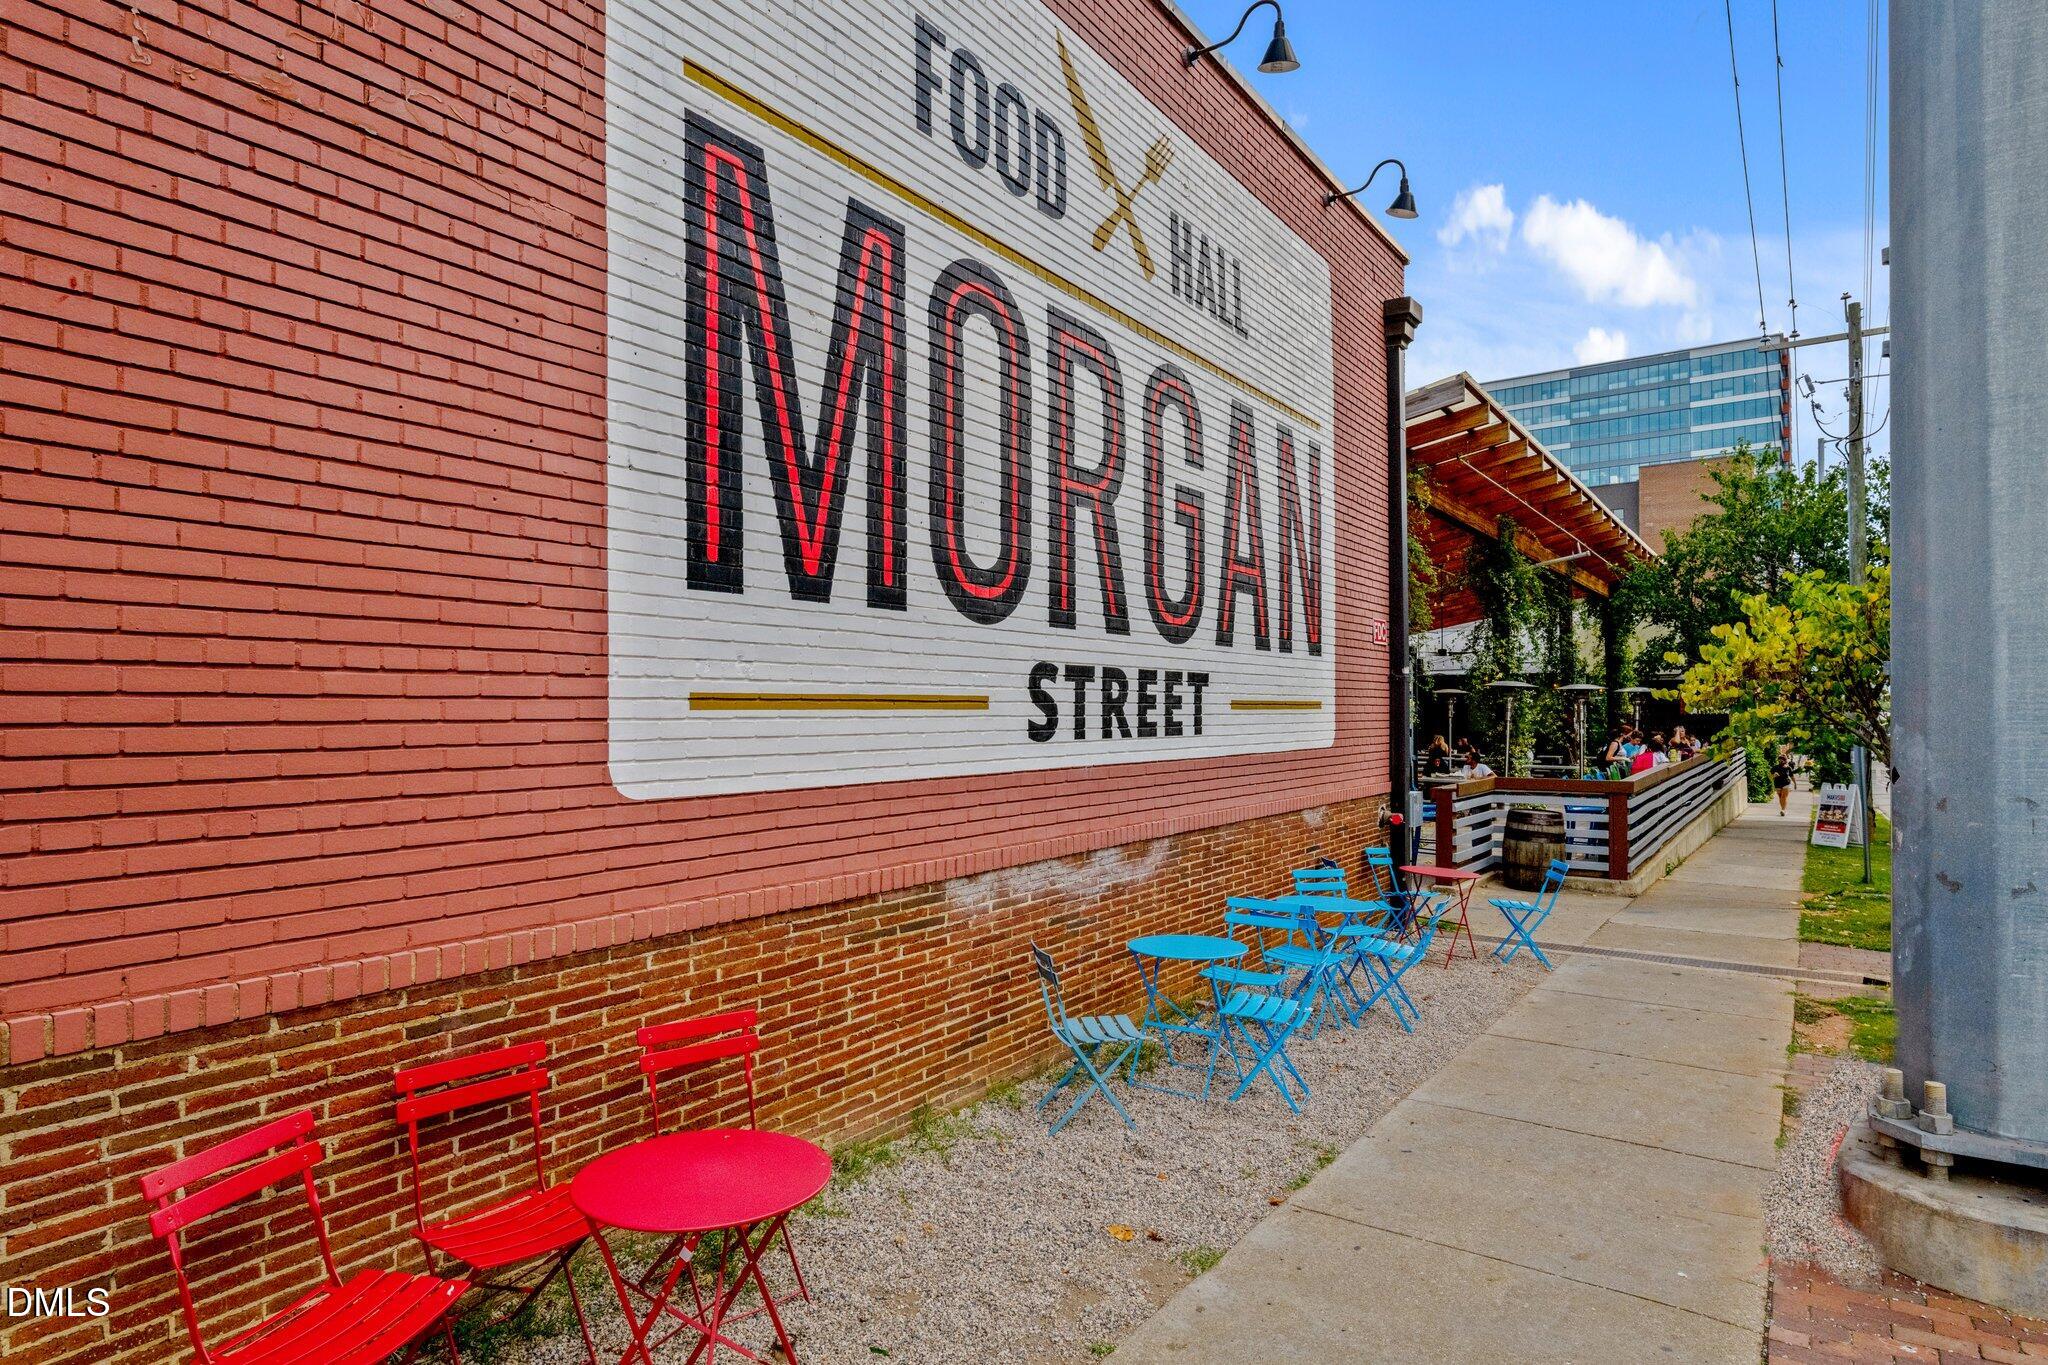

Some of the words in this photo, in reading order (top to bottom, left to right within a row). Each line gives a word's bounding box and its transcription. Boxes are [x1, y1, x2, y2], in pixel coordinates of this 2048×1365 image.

[914, 14, 1067, 220] FOOD
[1170, 211, 1249, 340] HALL
[684, 108, 1322, 656] MORGAN
[1028, 661, 1209, 742] STREET
